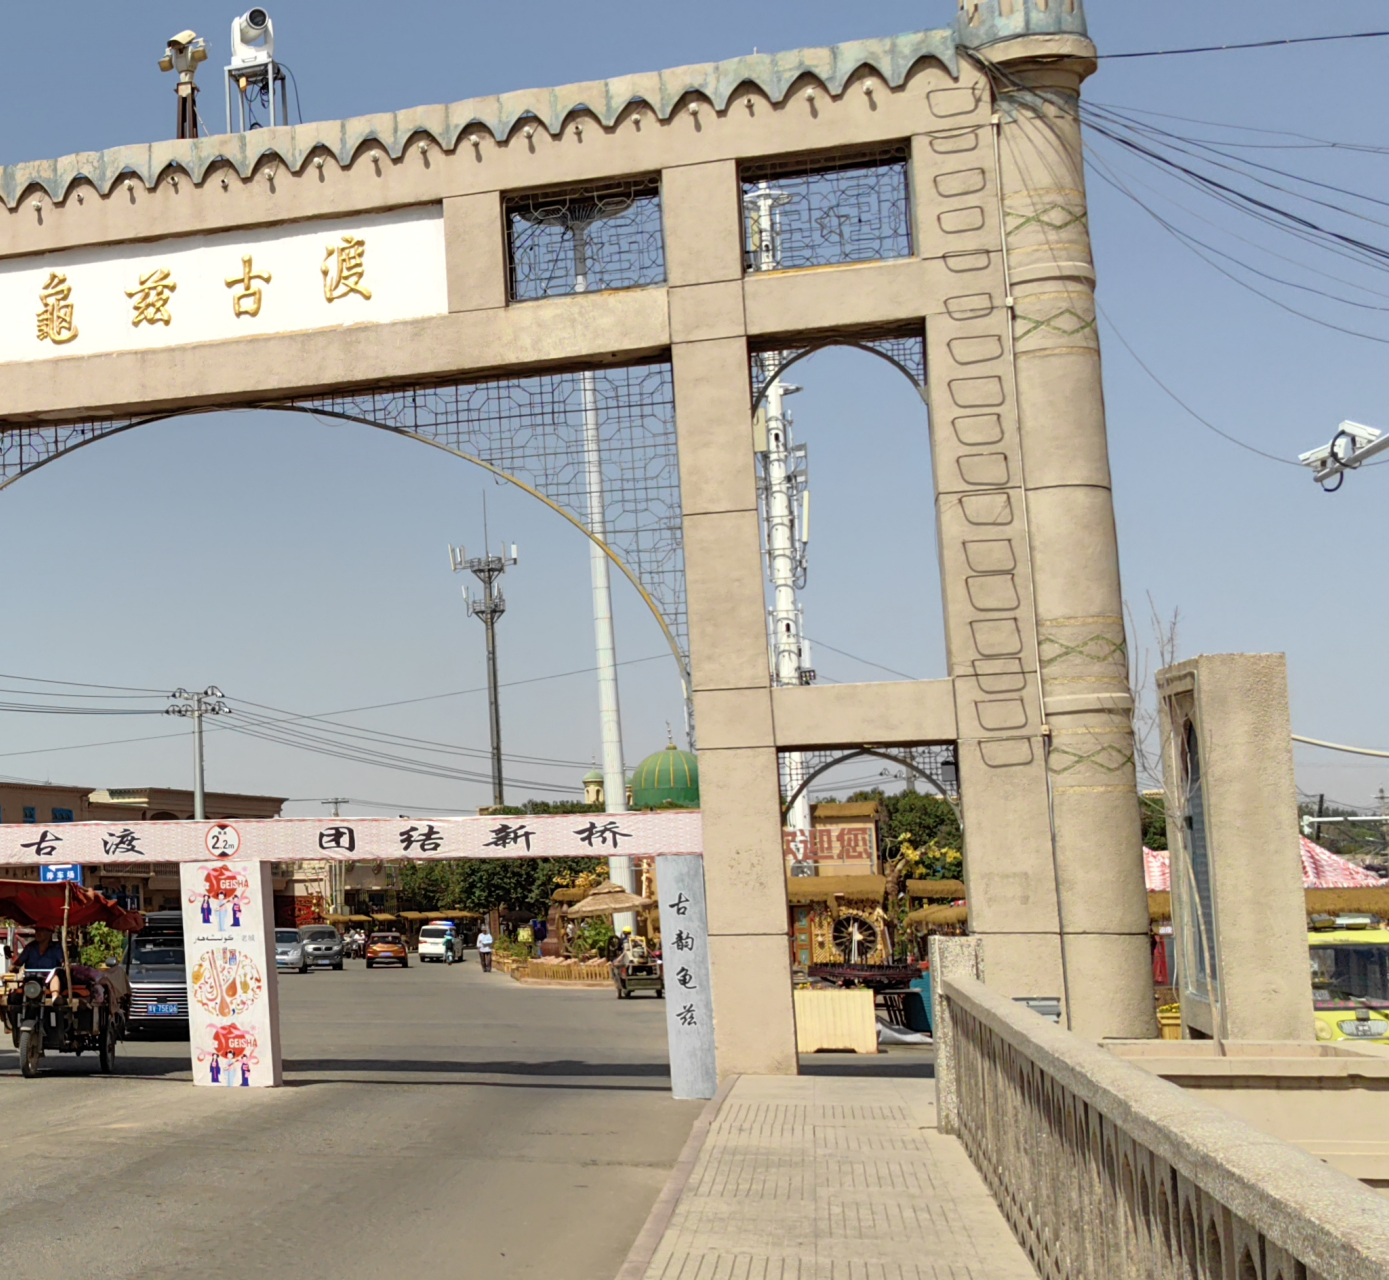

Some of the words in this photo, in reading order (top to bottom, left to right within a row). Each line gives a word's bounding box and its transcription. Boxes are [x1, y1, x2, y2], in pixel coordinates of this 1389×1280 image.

[318, 821, 633, 852] 团结新桥
[46, 870, 75, 880] 停车场
[220, 879, 249, 889] GEISHA
[668, 892, 698, 1026] 古韵龟兹
[228, 1037, 258, 1048] GEISHA
